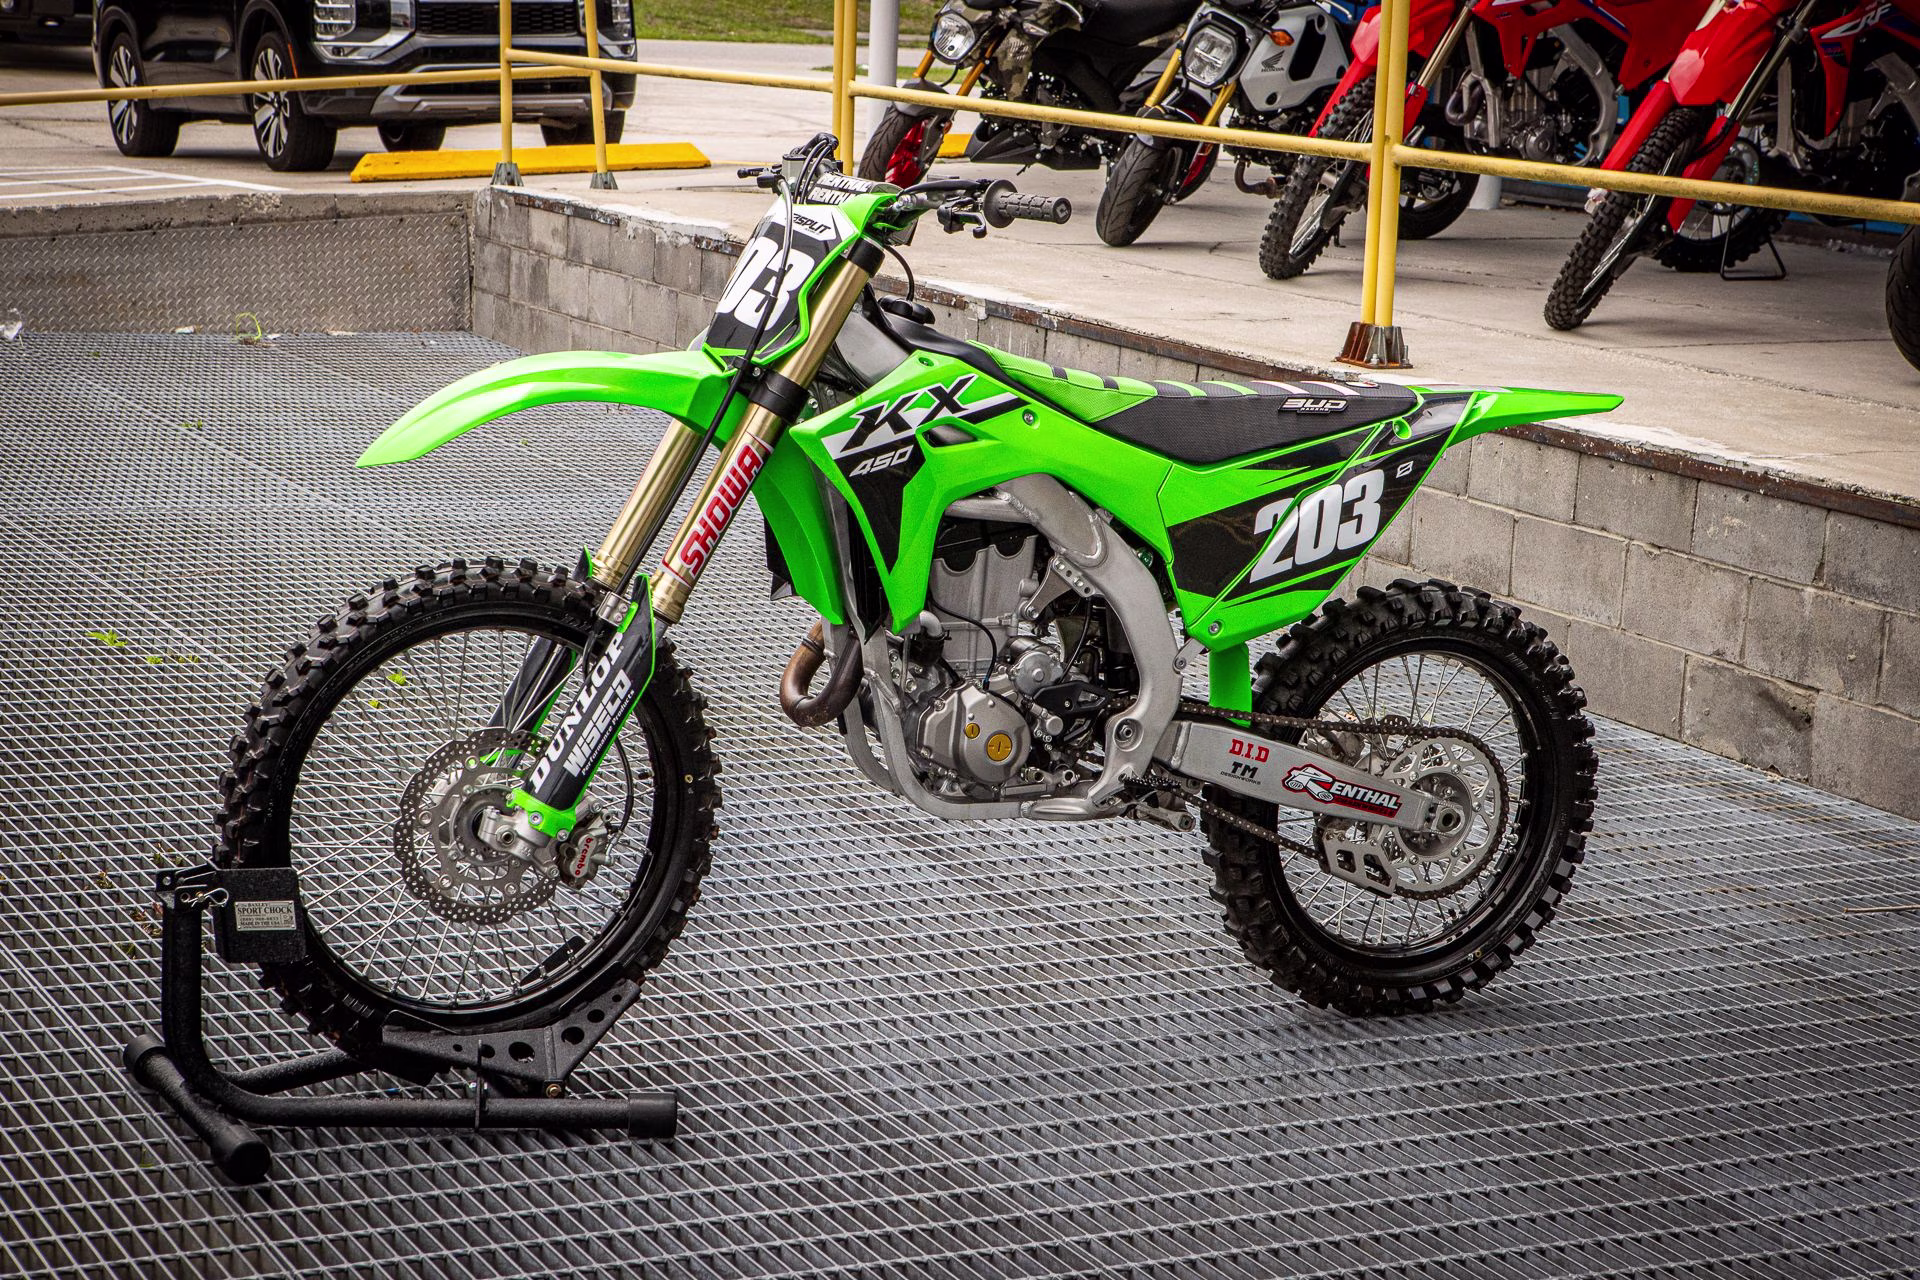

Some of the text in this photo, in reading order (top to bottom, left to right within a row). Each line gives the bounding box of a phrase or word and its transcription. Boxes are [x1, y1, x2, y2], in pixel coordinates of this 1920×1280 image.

[807, 187, 857, 205] RENTH
[840, 373, 979, 453] KX
[849, 445, 914, 477] 450
[681, 443, 764, 580] SHOWA
[1249, 469, 1385, 584] 203
[529, 632, 624, 793] DUNLOP
[581, 689, 635, 776] Performance Products
[1229, 738, 1270, 763] D.I.D
[1231, 761, 1259, 779] TM
[575, 837, 593, 876] brembo
[237, 906, 293, 915] SPORT CHOCK
